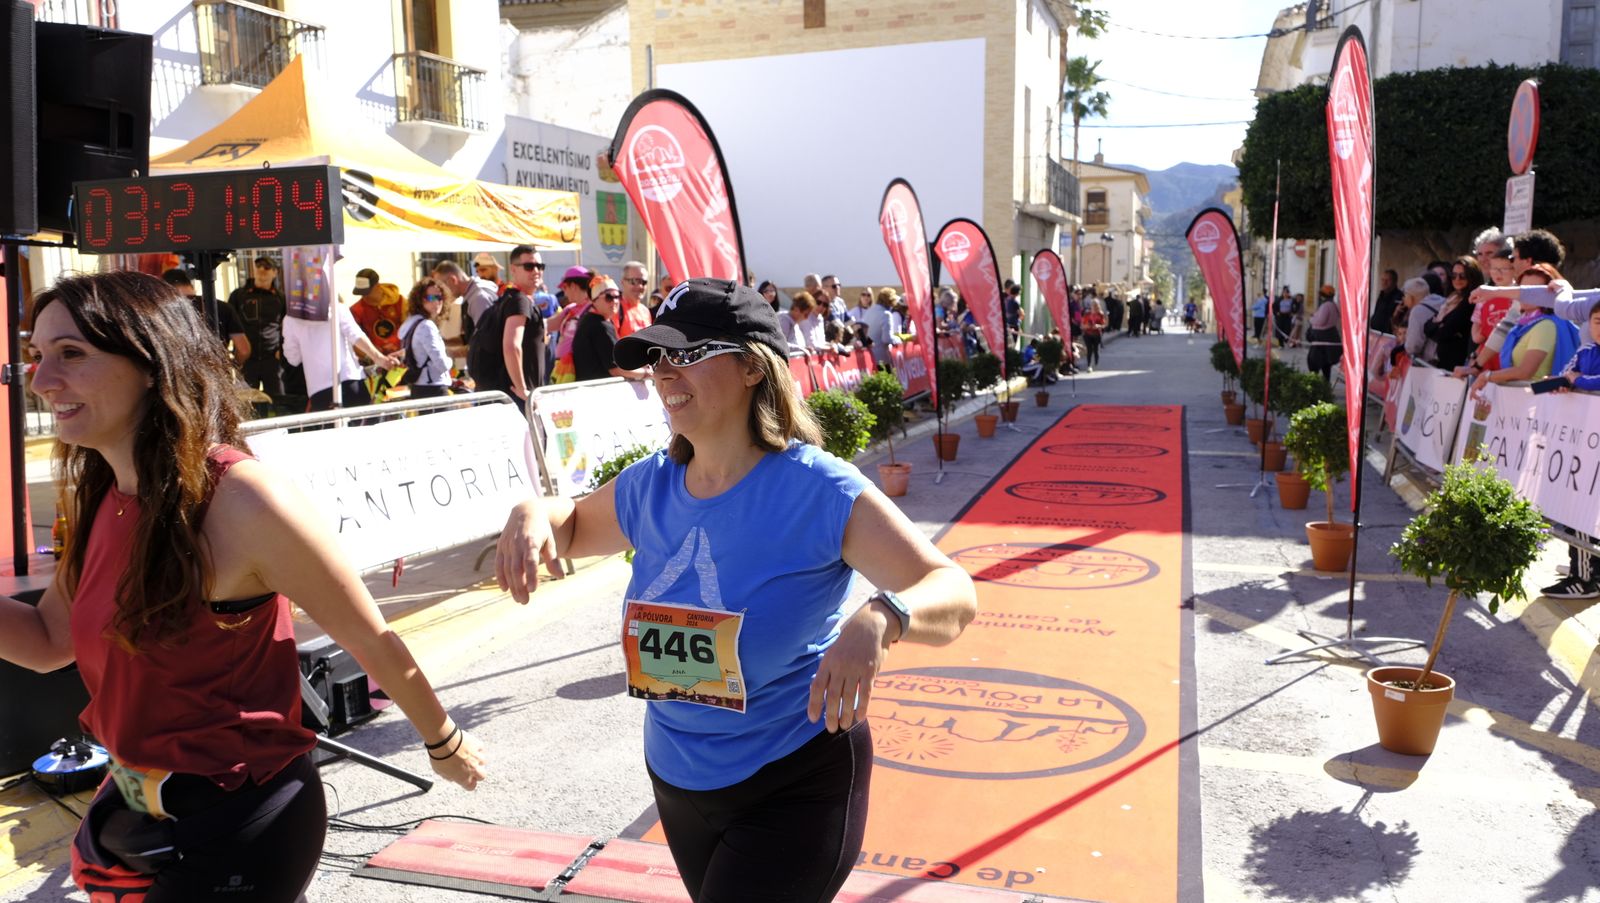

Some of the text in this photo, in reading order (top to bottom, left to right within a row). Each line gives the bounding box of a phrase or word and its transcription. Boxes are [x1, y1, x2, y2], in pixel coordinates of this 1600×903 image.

[513, 141, 591, 170] EXCELENTÍSIMO
[515, 169, 590, 195] AYUNTAMIENTO
[686, 613, 714, 623] CANTORIA
[639, 627, 715, 665] 446
[1056, 696, 1104, 710] LA
[976, 867, 1035, 888] de
